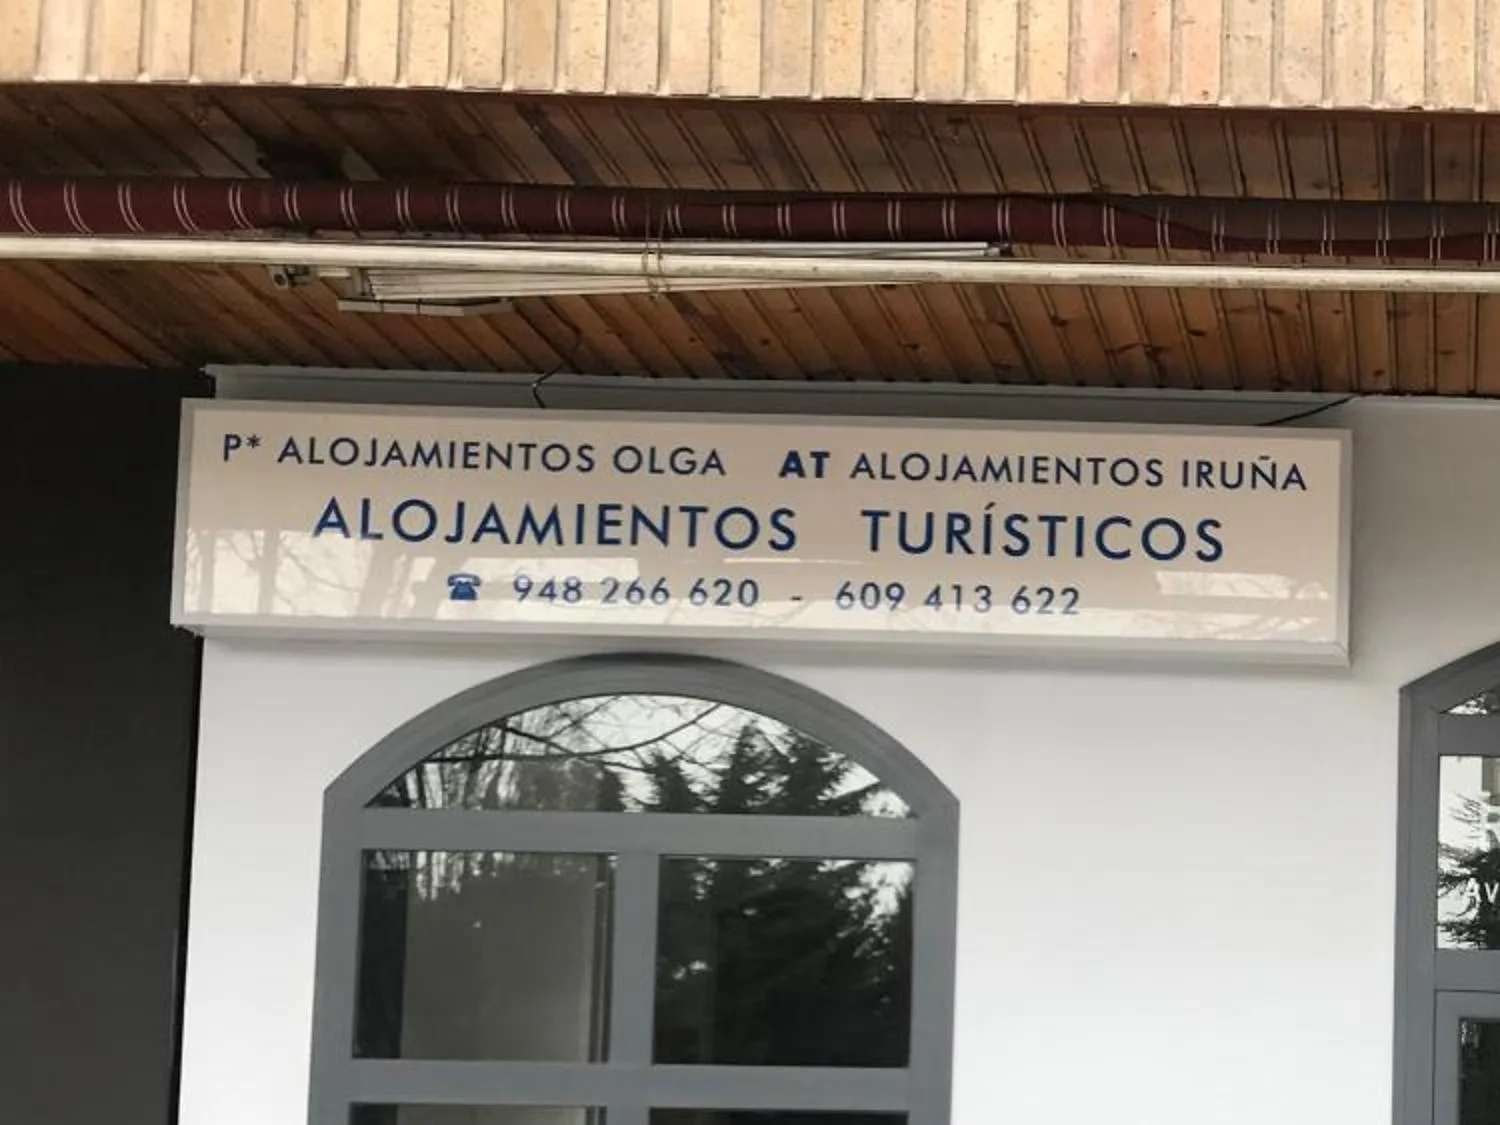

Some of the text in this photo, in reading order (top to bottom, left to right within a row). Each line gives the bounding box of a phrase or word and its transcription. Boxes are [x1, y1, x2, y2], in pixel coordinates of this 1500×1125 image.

[277, 435, 596, 473] ALOJAMIENTOS
[612, 446, 726, 477] OLGA
[778, 451, 830, 479] AT
[850, 451, 1164, 488] ALOJAMIENTOS
[1181, 454, 1308, 492] IRUÑA
[312, 497, 1224, 563] ALOJAMIENTOS TURÍSTICOS
[512, 576, 583, 605] 948
[601, 577, 670, 606] 266
[688, 579, 760, 608] 620
[835, 580, 905, 612] 609
[924, 583, 993, 614] 413
[1011, 585, 1081, 616] 622
